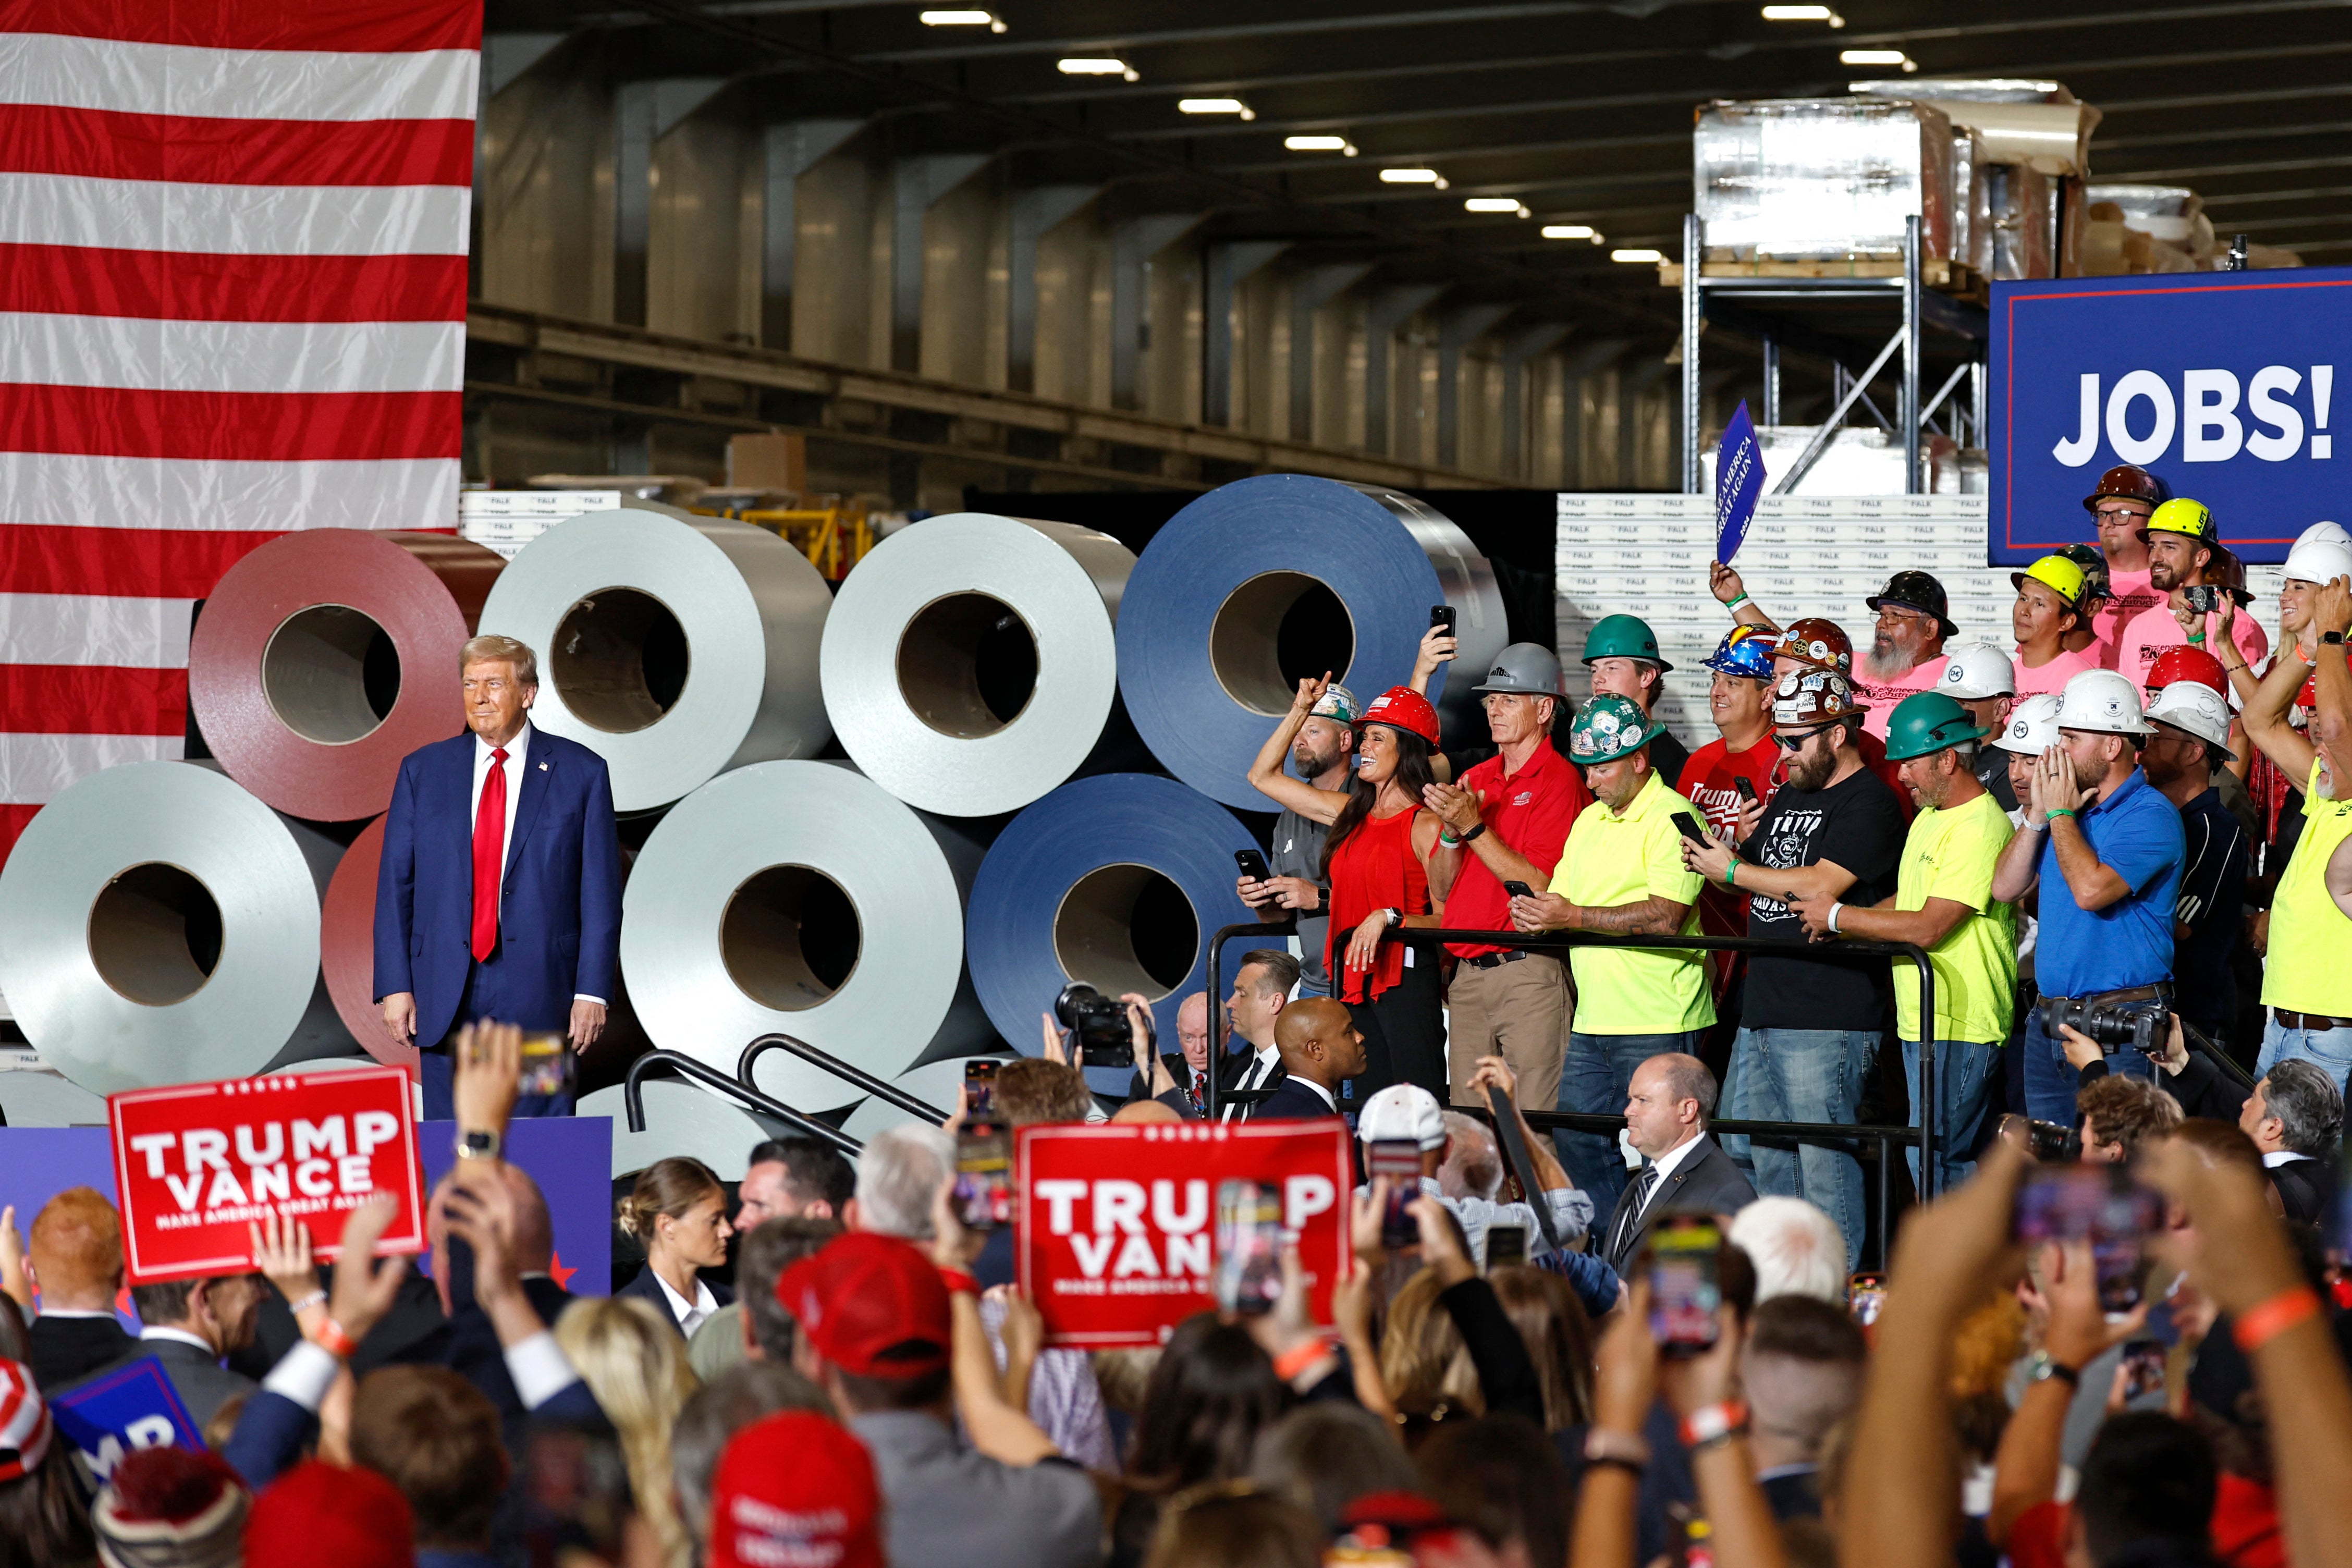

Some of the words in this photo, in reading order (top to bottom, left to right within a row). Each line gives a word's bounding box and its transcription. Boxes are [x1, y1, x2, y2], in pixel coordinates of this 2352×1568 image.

[2052, 365, 2333, 468] JOBS!
[1721, 435, 1752, 494] AMERICA
[1732, 454, 1753, 502] AGAIN
[1740, 514, 1750, 538] 2024
[2196, 509, 2207, 531] LIFT
[130, 1110, 399, 1180] TRUMP
[165, 1155, 373, 1212] VANCE
[1034, 1173, 1337, 1236] TRUP
[156, 1209, 202, 1232] MAKE
[204, 1202, 276, 1225] AMERICA
[277, 1196, 330, 1217] GREAT
[1069, 1233, 1211, 1279] VAN
